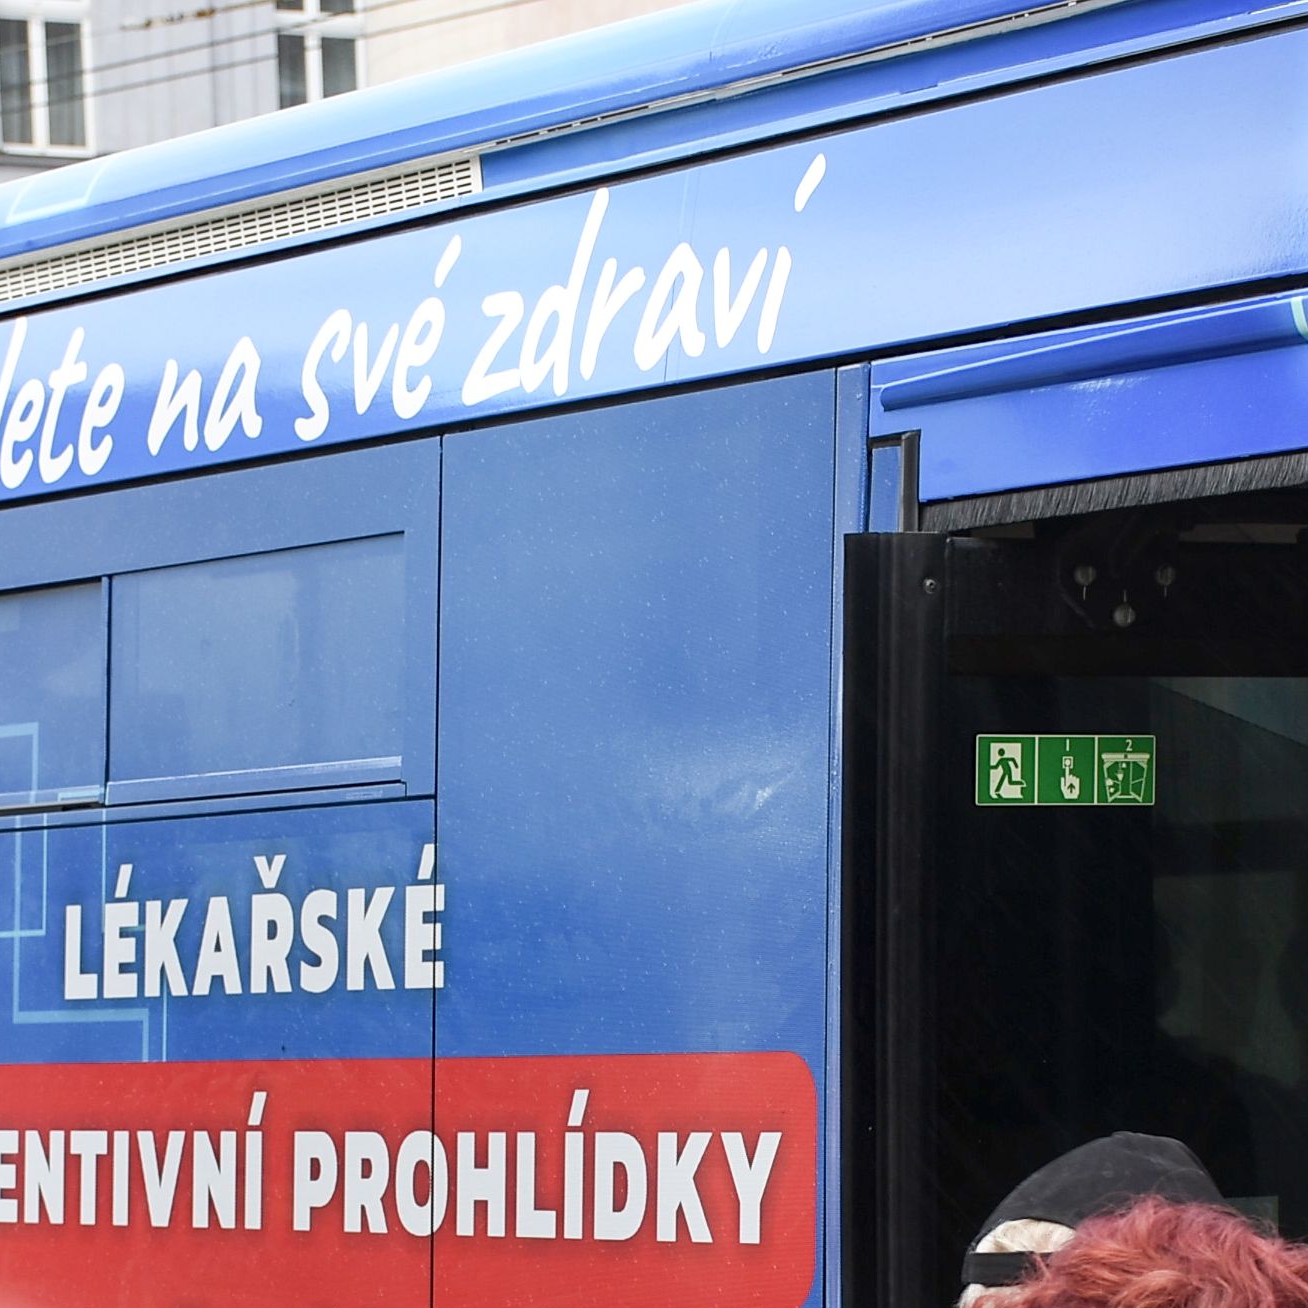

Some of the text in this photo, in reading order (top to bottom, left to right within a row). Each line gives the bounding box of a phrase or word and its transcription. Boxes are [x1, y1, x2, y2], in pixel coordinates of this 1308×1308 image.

[147, 335, 262, 455] na
[294, 234, 462, 442] své
[461, 153, 826, 406] zdraví
[1125, 739, 1133, 751] 2
[64, 843, 446, 1000] LÉKAŘSKÉ
[293, 1089, 782, 1245] PROHLÍDKY
